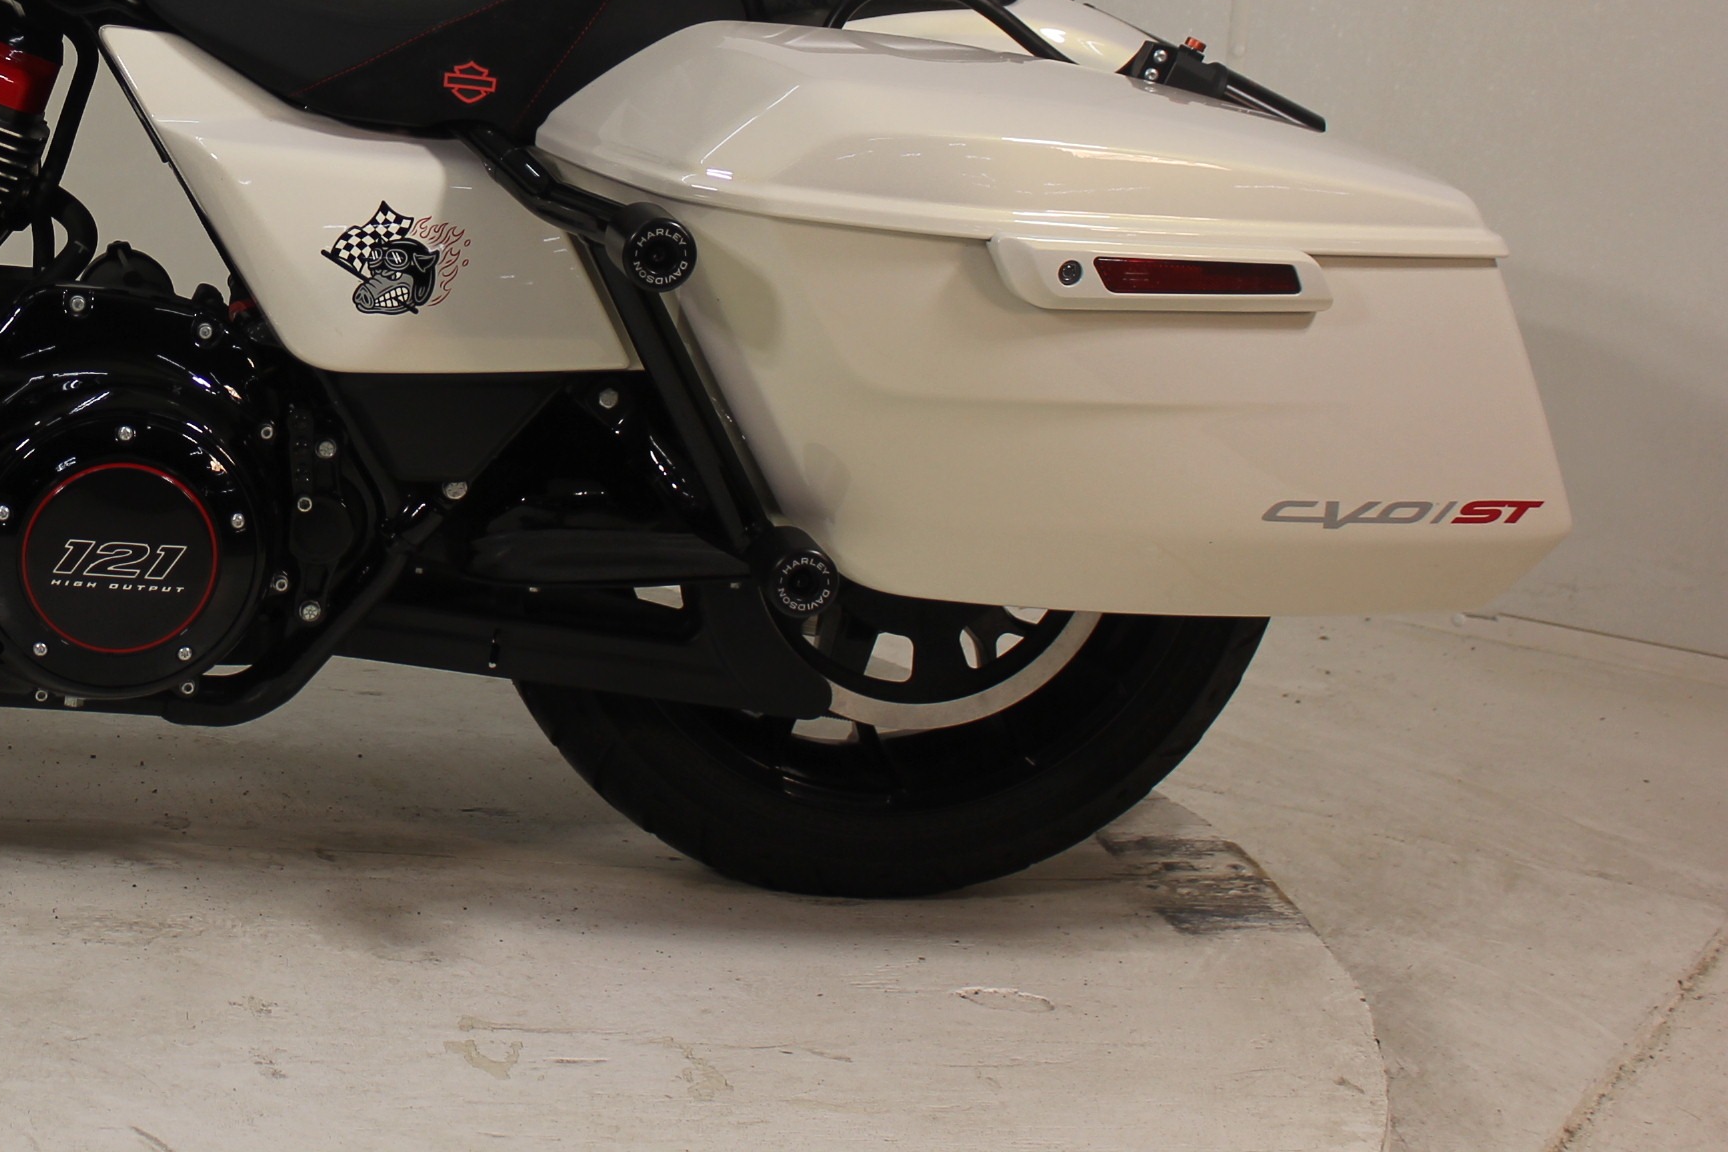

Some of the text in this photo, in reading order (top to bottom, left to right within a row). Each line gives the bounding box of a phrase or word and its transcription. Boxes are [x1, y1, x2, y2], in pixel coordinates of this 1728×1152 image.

[633, 228, 688, 285] HARLEY DAVIDSON
[52, 539, 187, 579] 121
[50, 578, 185, 593] HIGH OUTPUT
[778, 557, 830, 611] HARLEY DAVIDSON
